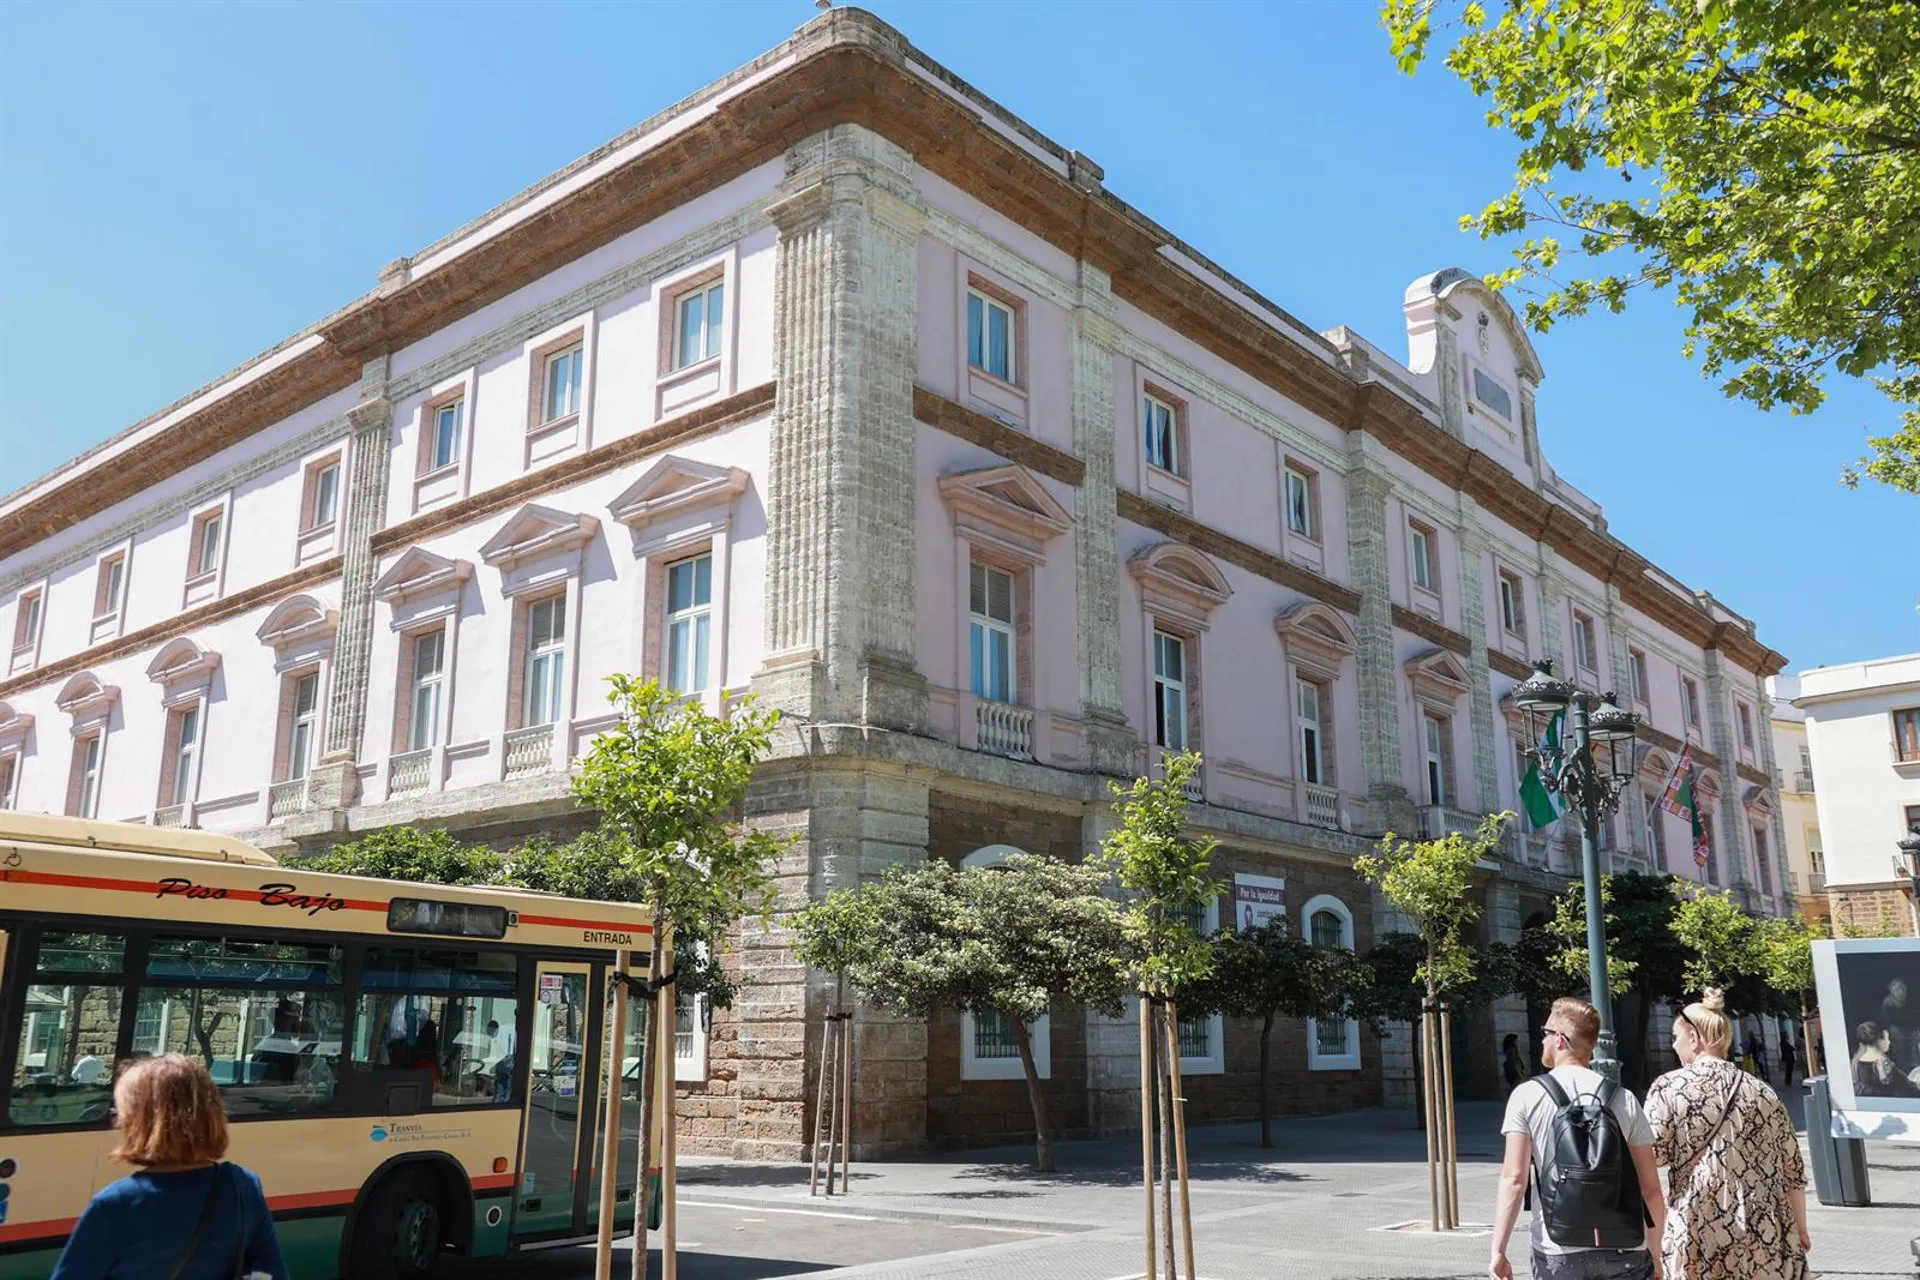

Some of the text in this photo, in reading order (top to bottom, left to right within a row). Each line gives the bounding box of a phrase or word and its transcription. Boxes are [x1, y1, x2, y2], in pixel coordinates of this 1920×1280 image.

[156, 877, 346, 916] Piso Bajo
[1240, 887, 1250, 899] Por
[583, 931, 632, 945] ENTRADA
